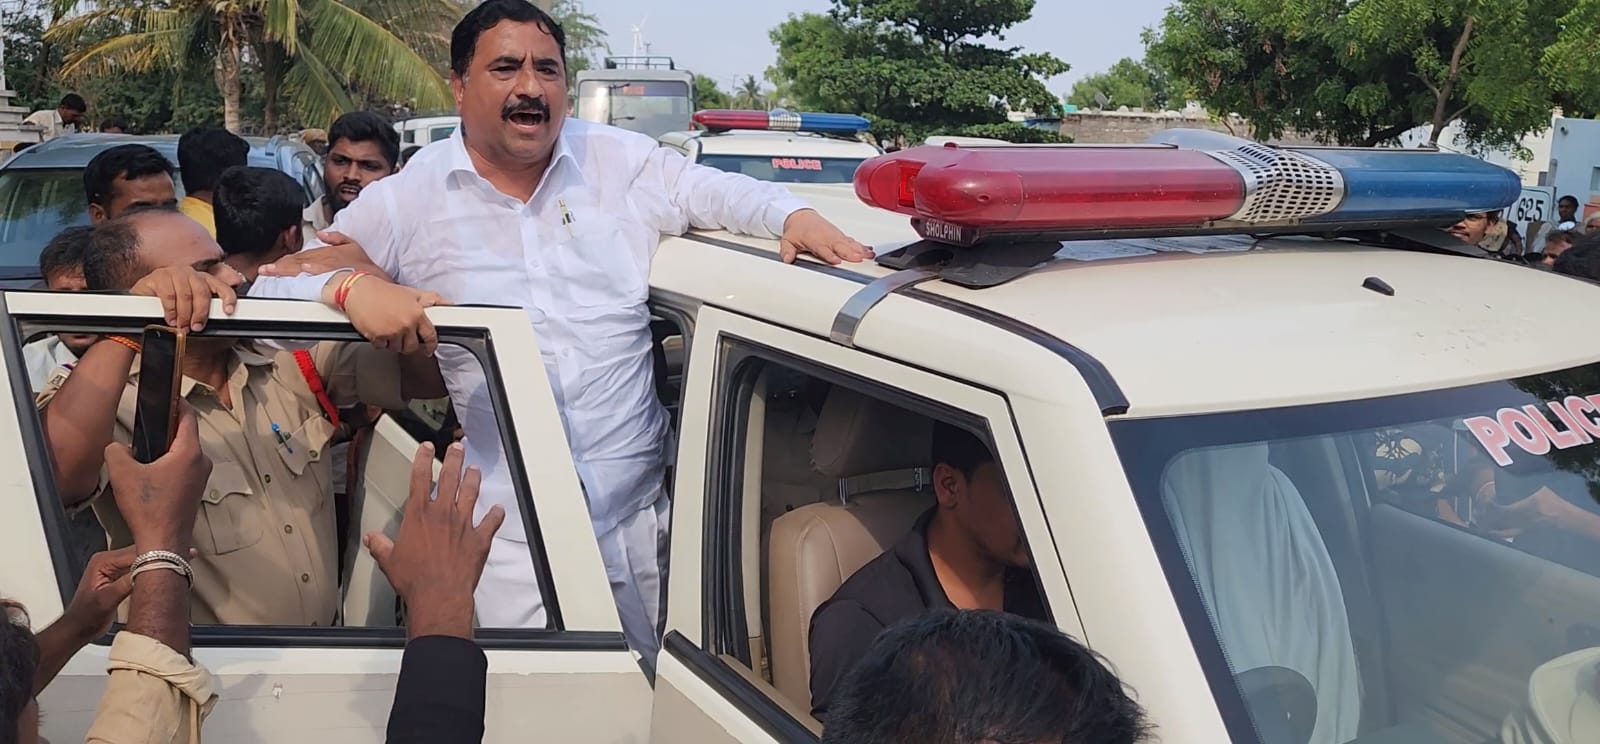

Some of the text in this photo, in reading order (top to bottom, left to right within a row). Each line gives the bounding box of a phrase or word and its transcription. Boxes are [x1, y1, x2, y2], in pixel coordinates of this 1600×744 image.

[771, 158, 823, 170] POLICE
[1517, 198, 1544, 221] 625
[1463, 393, 1600, 466] POLIC
